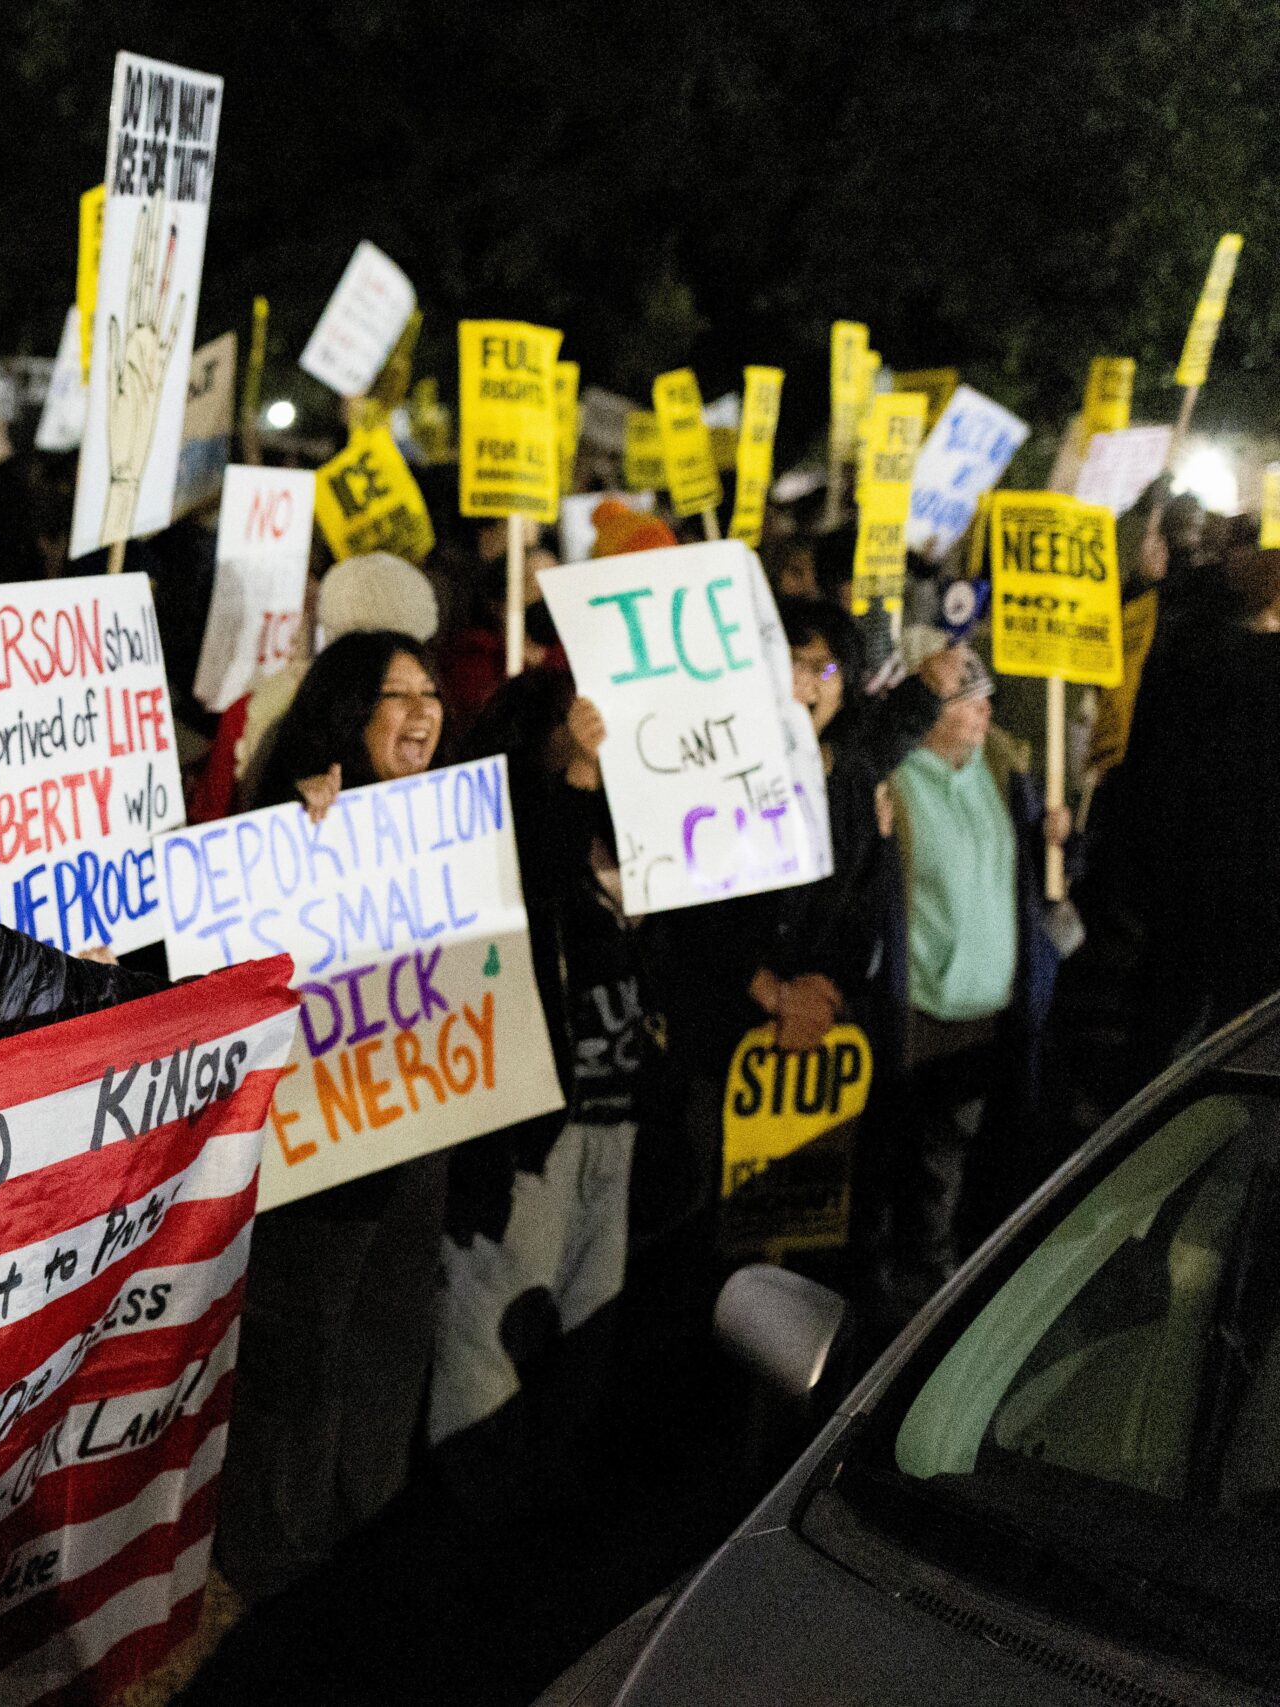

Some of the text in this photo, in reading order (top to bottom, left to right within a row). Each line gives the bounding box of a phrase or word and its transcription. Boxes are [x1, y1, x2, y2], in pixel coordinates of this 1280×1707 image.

[245, 488, 294, 543] NO
[1002, 530, 1108, 583] NEEDS
[104, 605, 160, 672] shall
[587, 576, 754, 686] ICE
[73, 687, 98, 744] of
[105, 686, 170, 759] LIFE
[635, 712, 742, 776] CANT
[124, 762, 169, 832] w/o
[164, 761, 504, 934] DEPORTATION
[197, 863, 479, 974] IS SMALL
[293, 944, 451, 1058] DICK
[269, 991, 496, 1168] ENERGY
[733, 1042, 862, 1118] STOP
[45, 1247, 78, 1294] to
